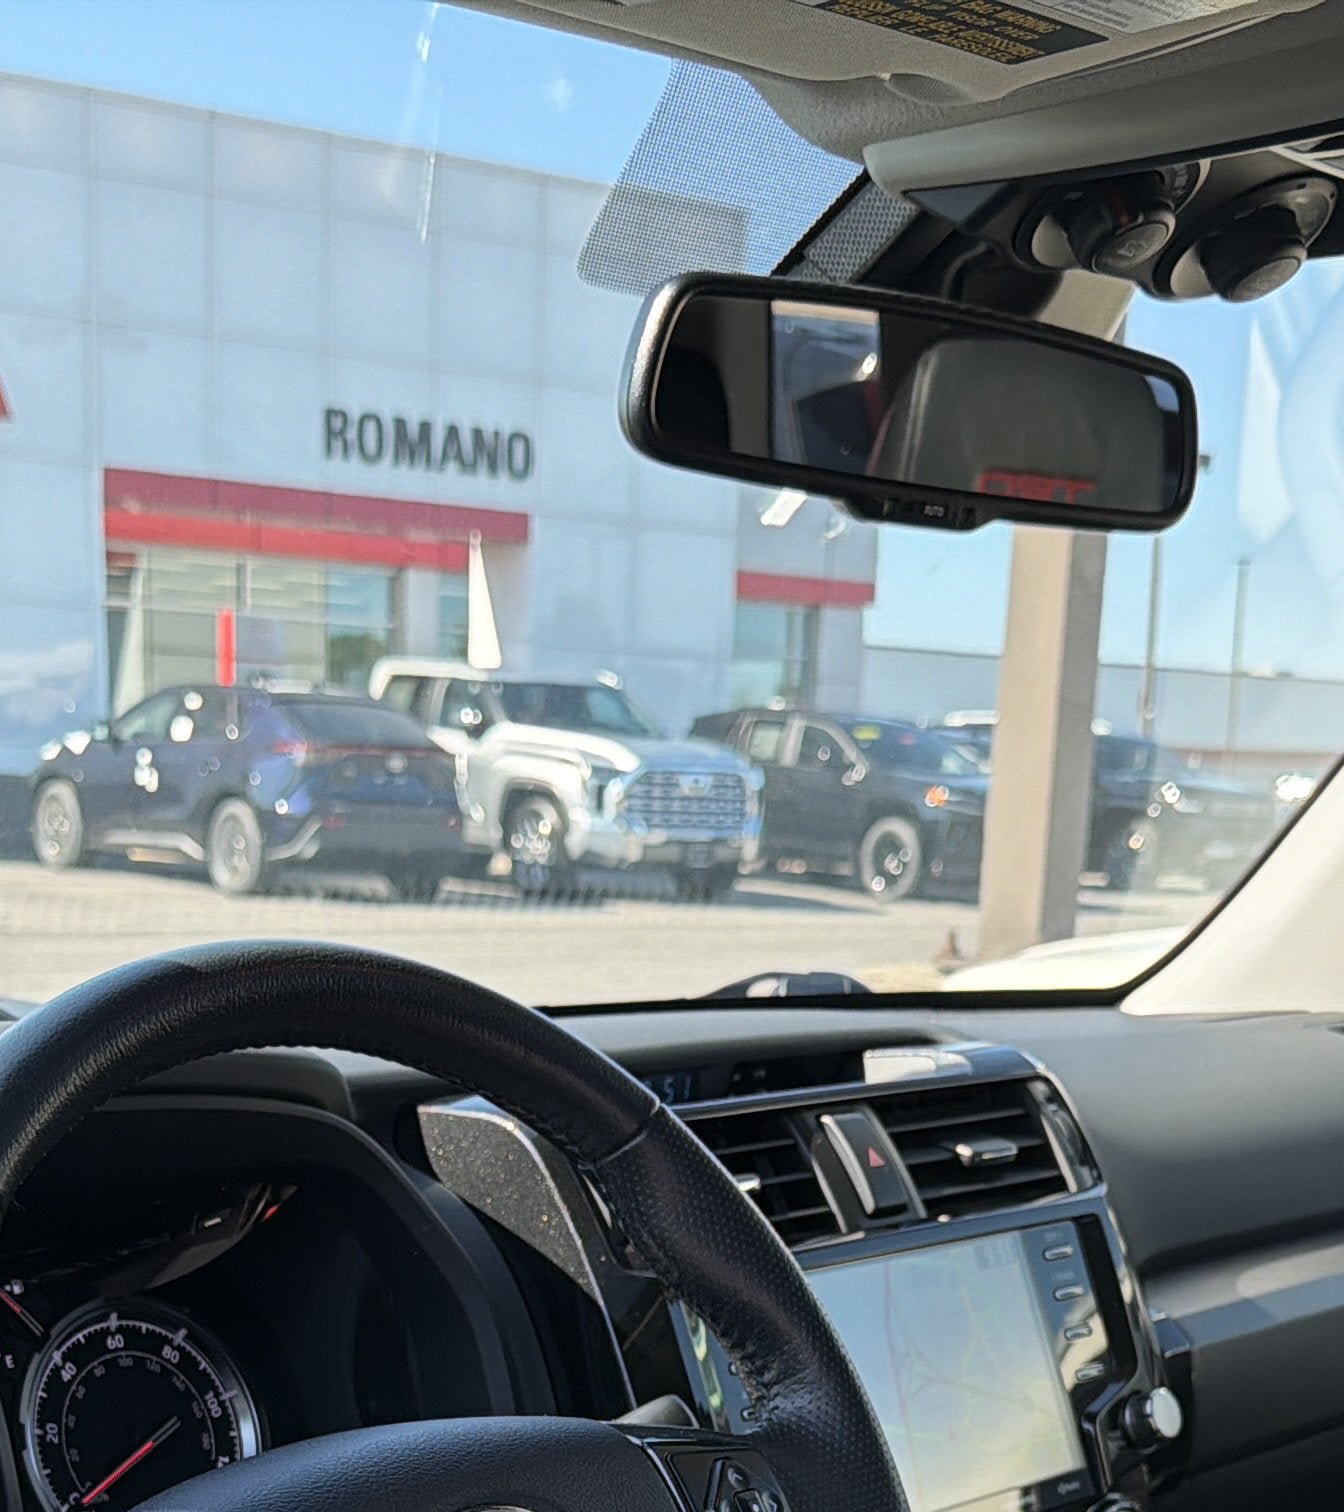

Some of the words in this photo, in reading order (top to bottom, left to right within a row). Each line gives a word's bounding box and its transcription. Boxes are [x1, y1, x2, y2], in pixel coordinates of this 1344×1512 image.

[323, 407, 533, 480] ROMANO
[106, 1333, 125, 1350] 60
[162, 1344, 180, 1365] 80
[60, 1362, 78, 1383] 40
[205, 1390, 223, 1419] 100
[45, 1422, 59, 1445] 20
